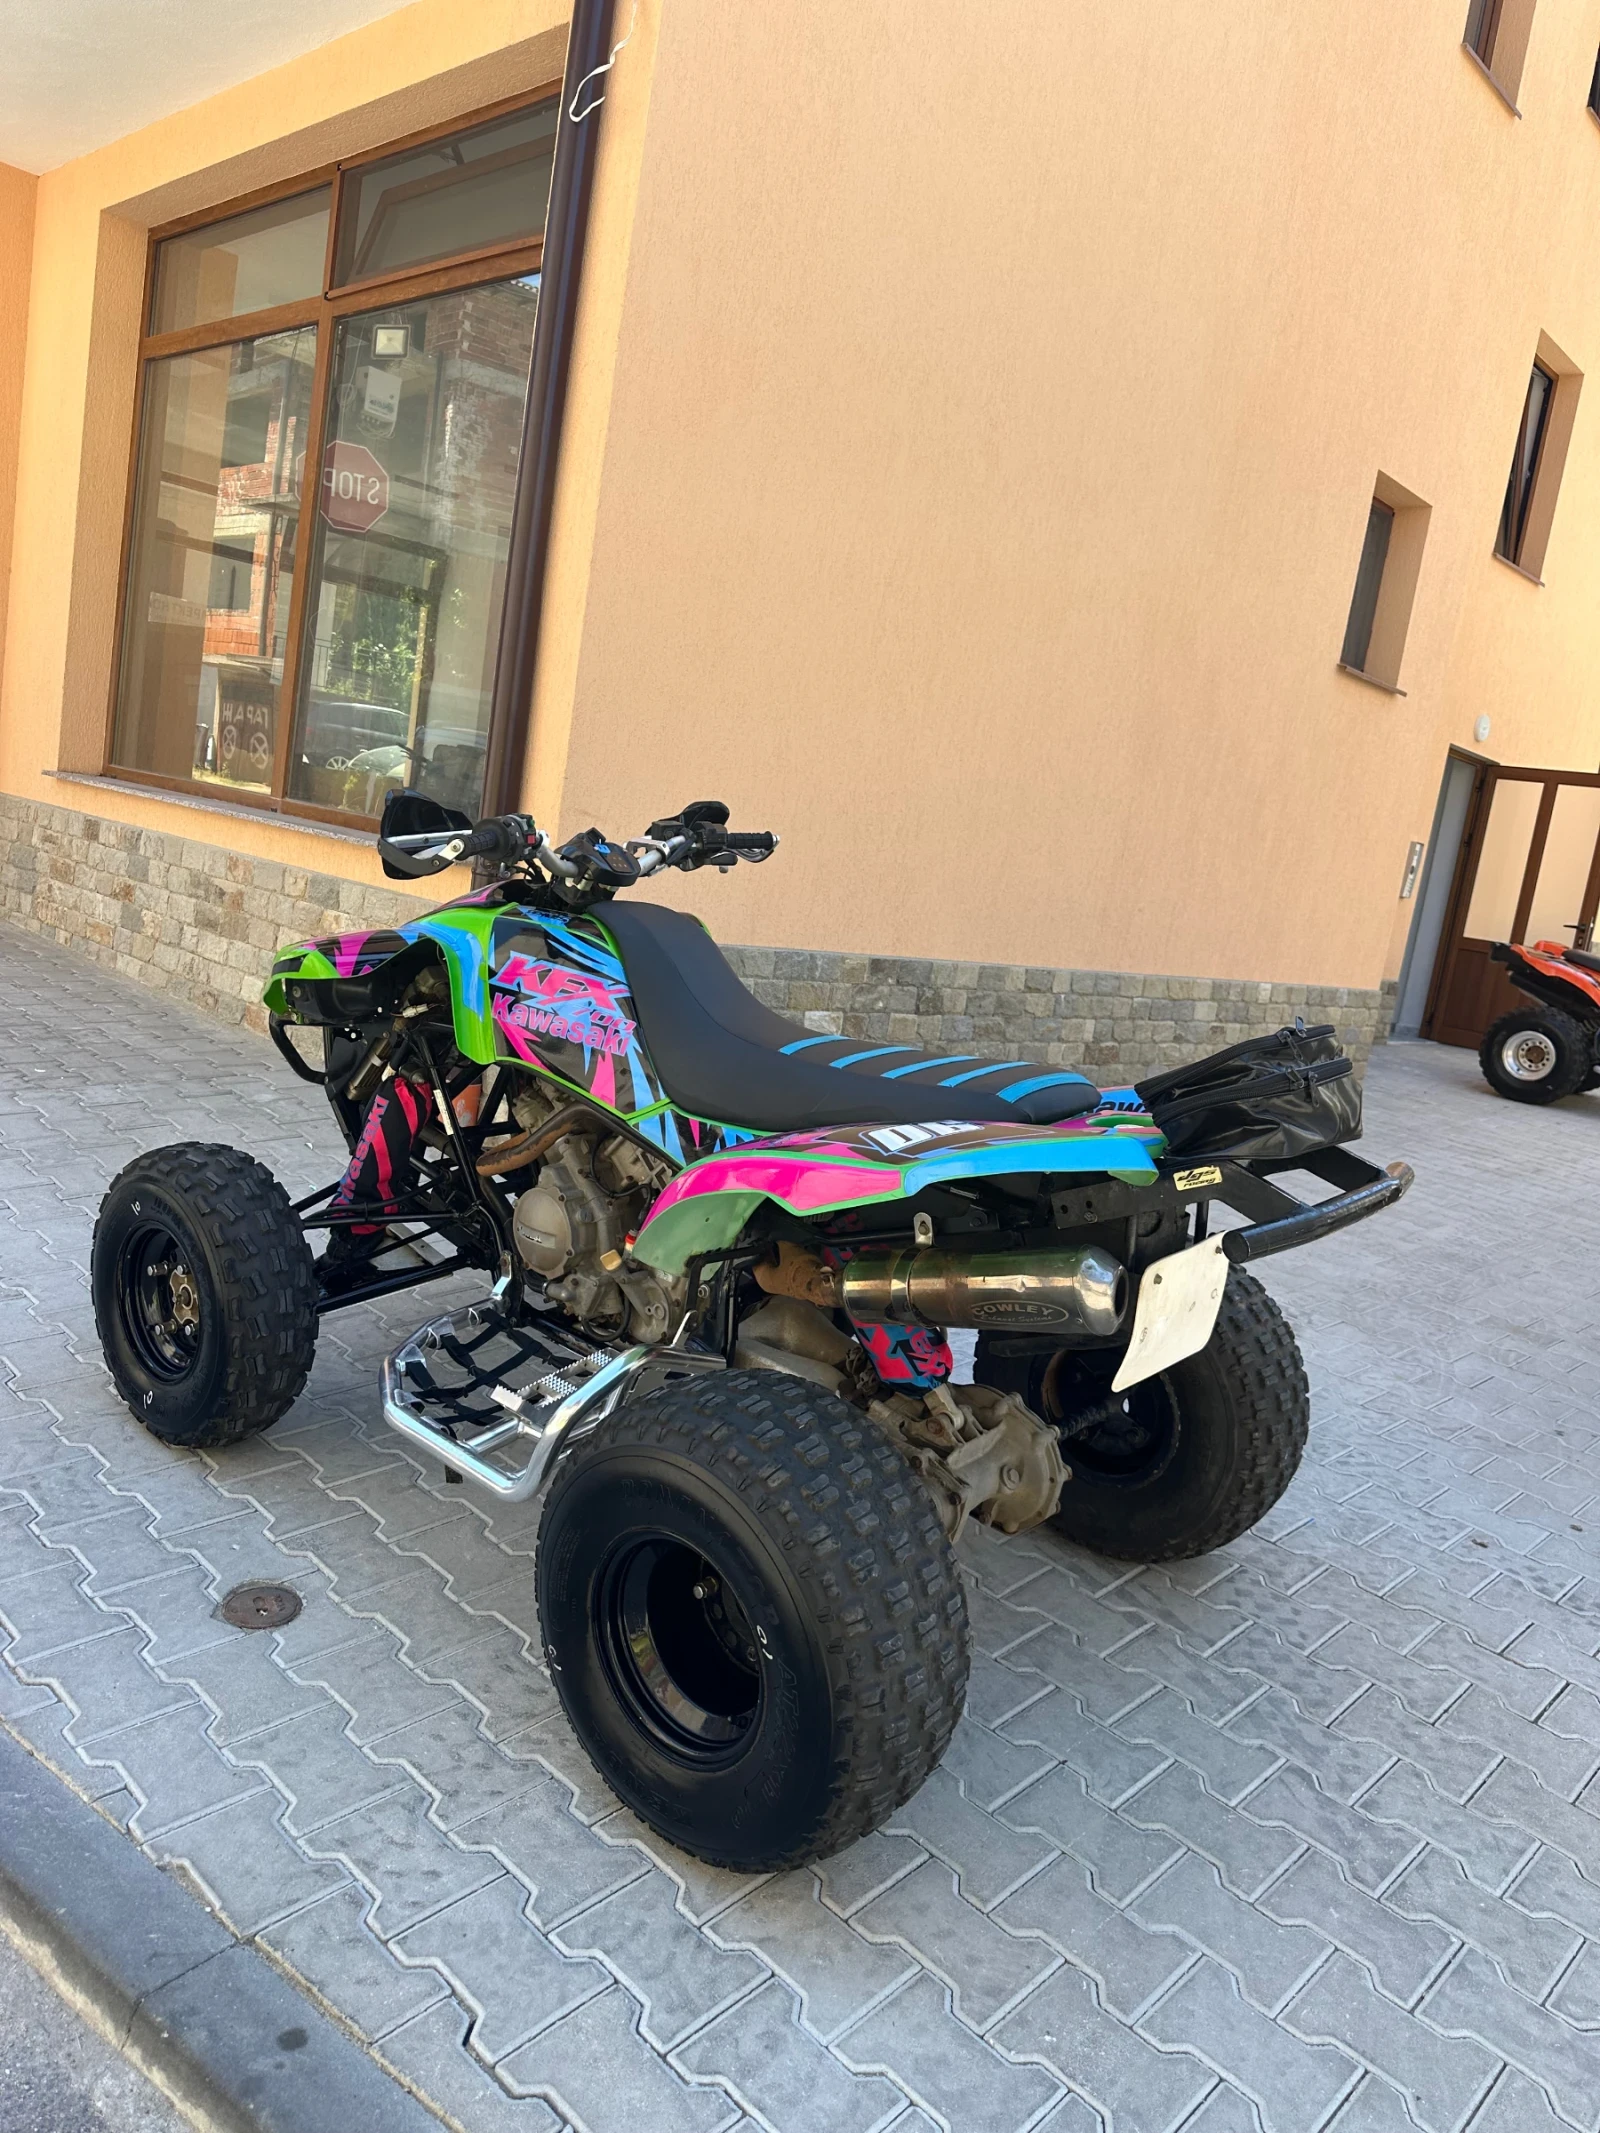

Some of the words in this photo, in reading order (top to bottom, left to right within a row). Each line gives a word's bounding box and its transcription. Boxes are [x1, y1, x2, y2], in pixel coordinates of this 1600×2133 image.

[490, 952, 632, 1013] KFX
[491, 992, 632, 1057] Kawasaki
[971, 1303, 1055, 1316] COWLEY
